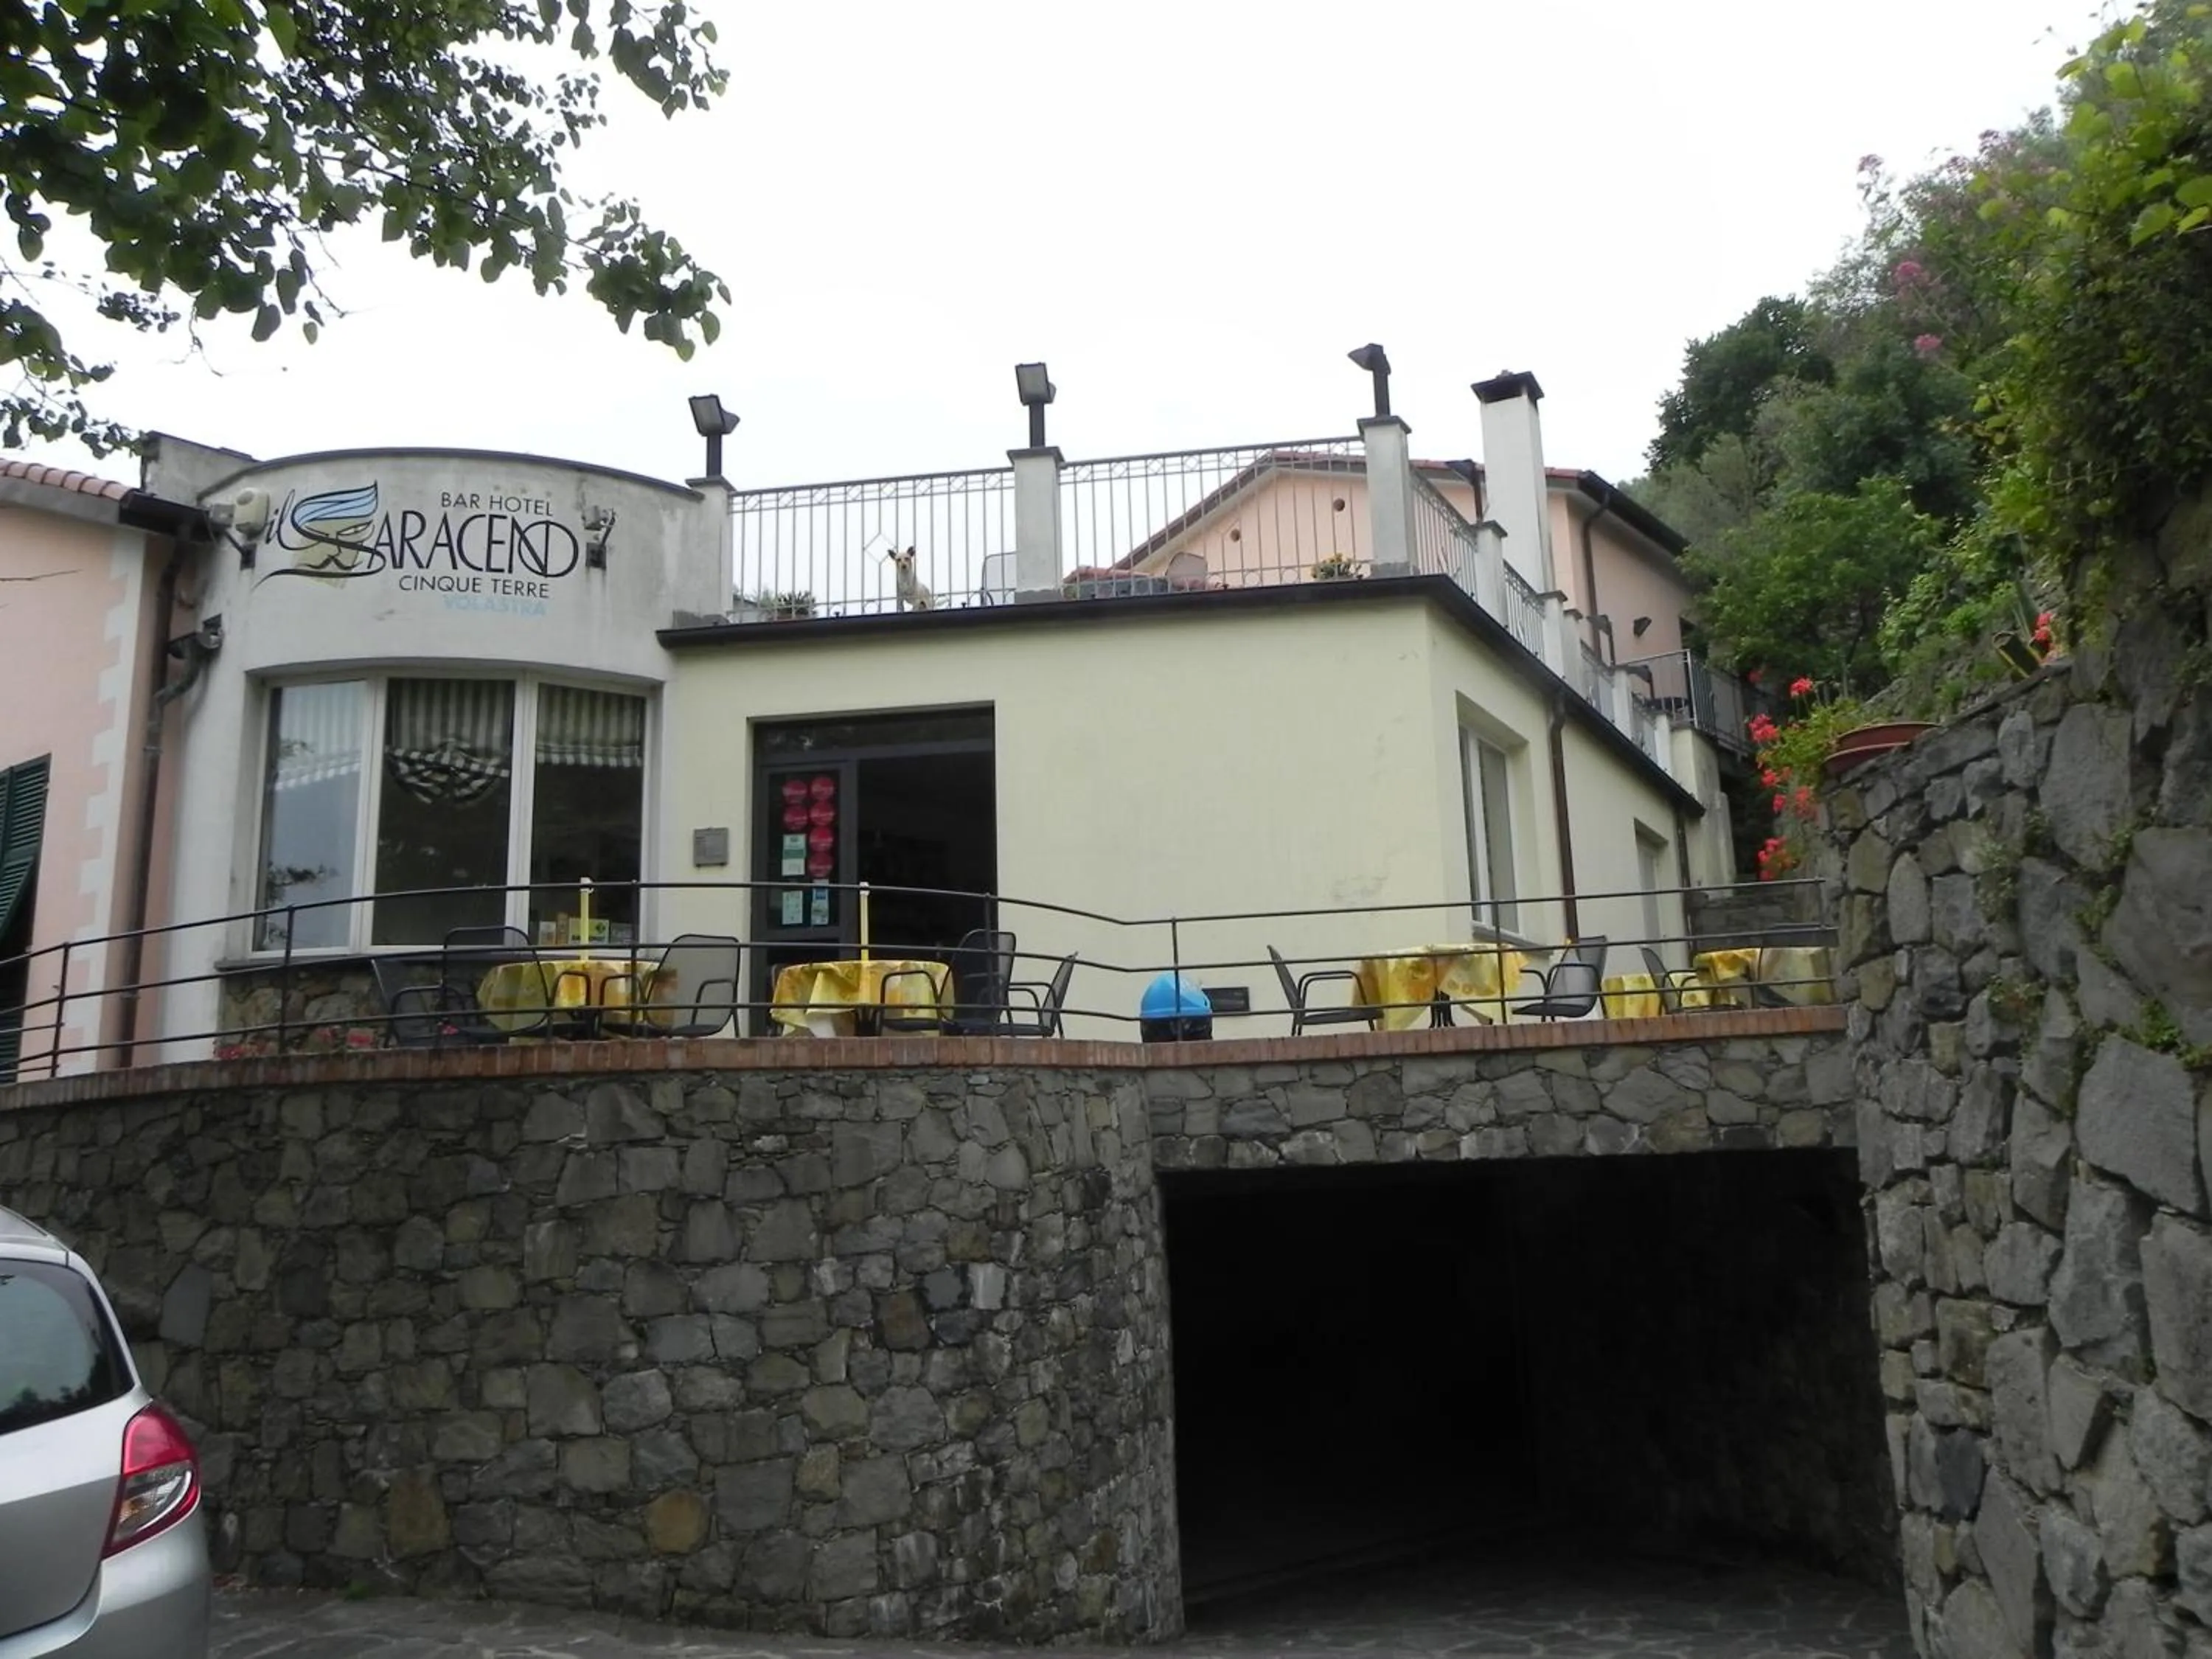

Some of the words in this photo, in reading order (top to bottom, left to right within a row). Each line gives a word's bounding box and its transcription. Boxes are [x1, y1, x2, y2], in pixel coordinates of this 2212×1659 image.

[442, 492, 480, 509] BAR
[490, 495, 553, 516] HOTEL
[399, 575, 481, 593] CINQUE
[491, 579, 550, 598] TERRE
